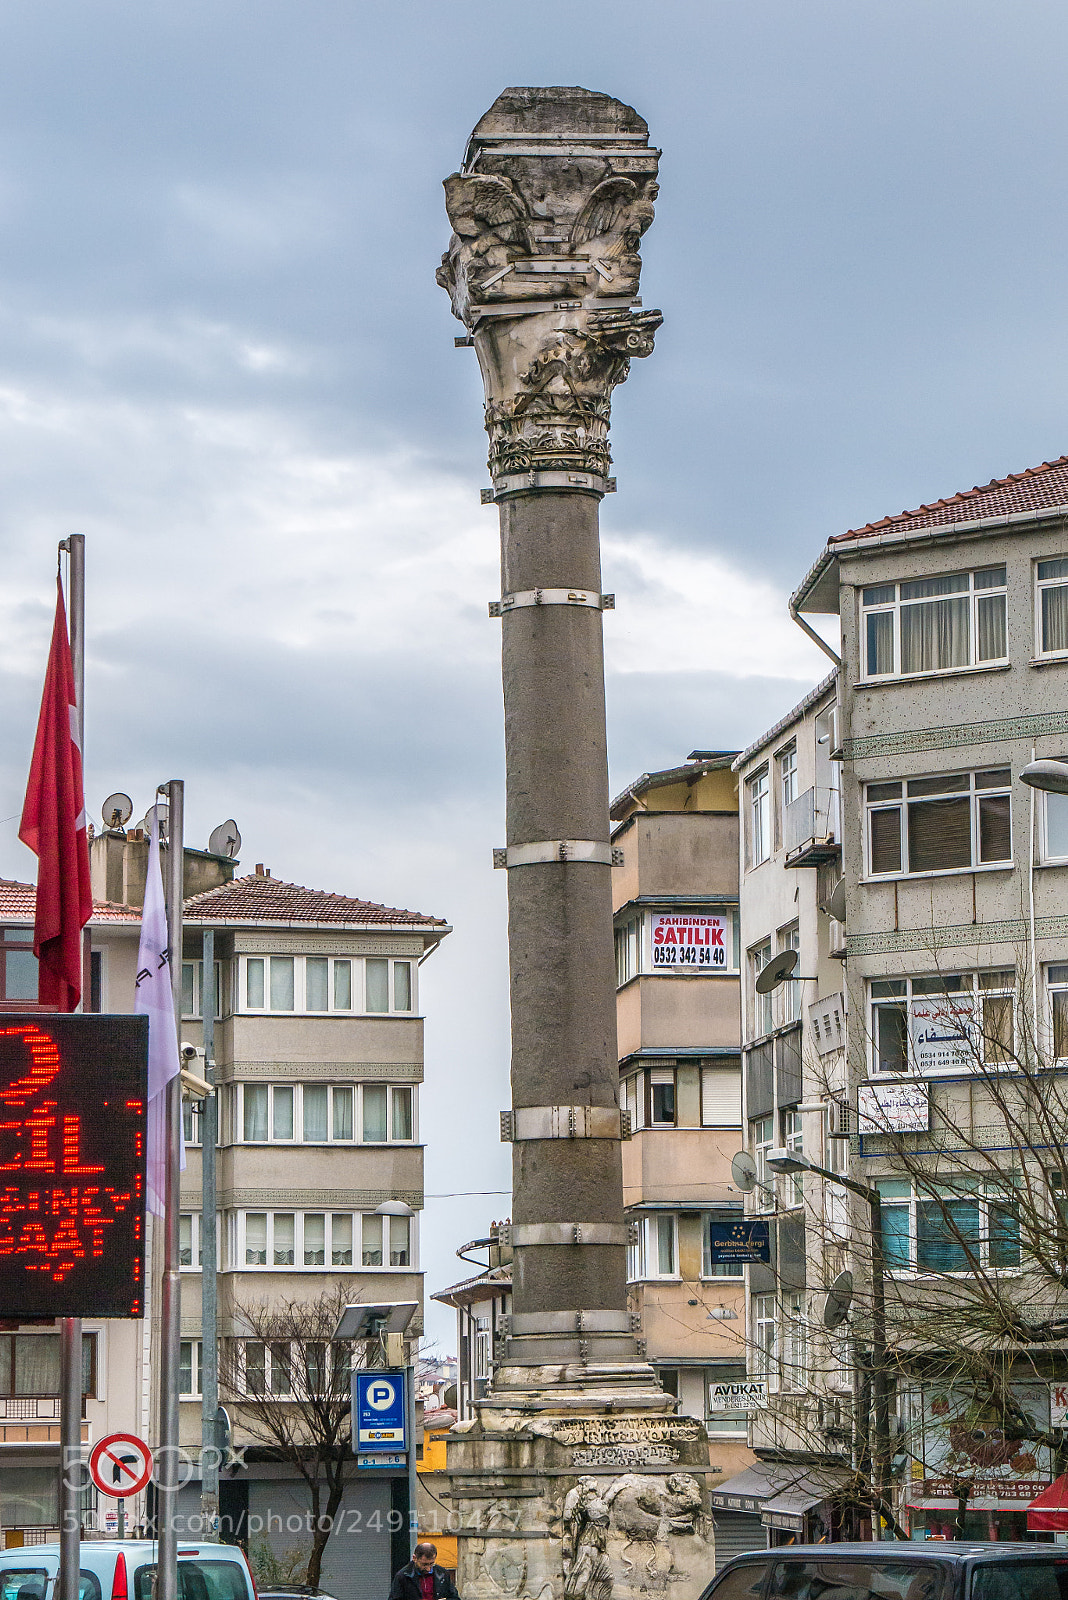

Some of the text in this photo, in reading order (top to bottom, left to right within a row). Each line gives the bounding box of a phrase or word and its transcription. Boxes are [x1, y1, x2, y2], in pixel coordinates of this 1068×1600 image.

[659, 917, 720, 927] SAHİBİNDEN
[653, 927, 724, 946] SATILIK
[654, 947, 724, 964] 0532 342 54 40
[373, 1387, 390, 1403] P
[714, 1384, 764, 1395] AVUKAT
